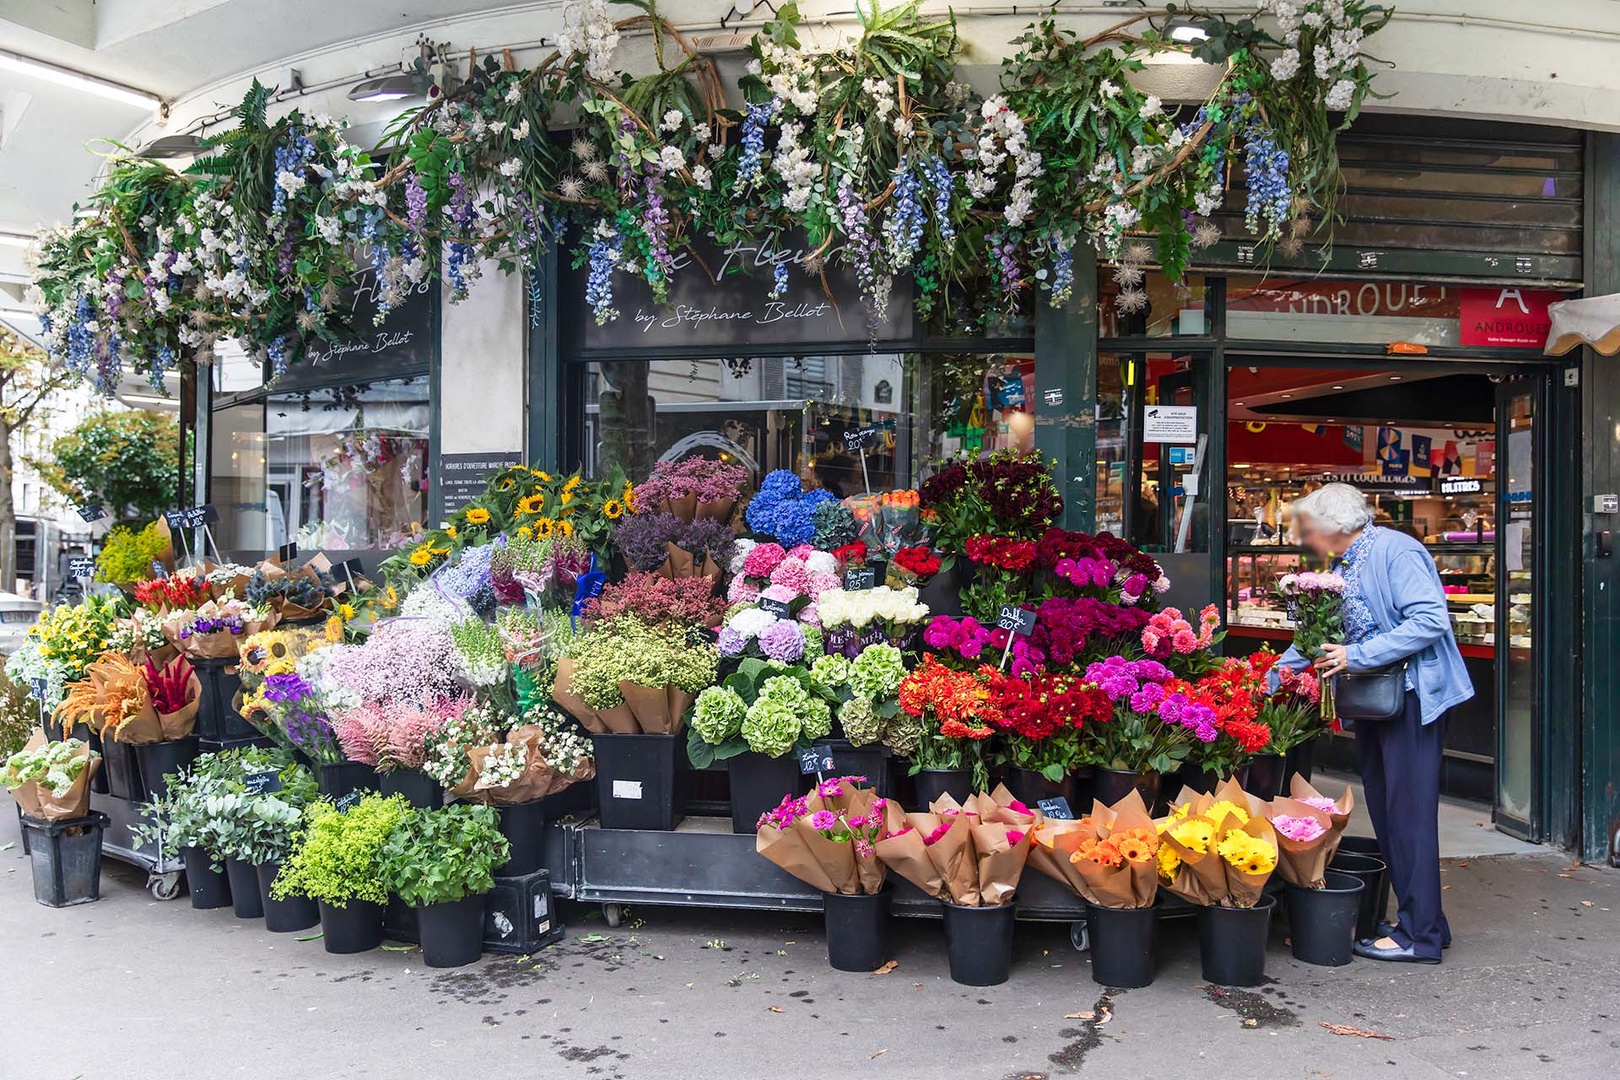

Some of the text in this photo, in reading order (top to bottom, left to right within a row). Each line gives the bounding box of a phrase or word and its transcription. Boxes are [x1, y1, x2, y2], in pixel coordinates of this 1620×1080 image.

[634, 308, 658, 332] by
[756, 301, 832, 323] Bellot
[308, 346, 320, 366] by
[372, 330, 414, 354] Bellot
